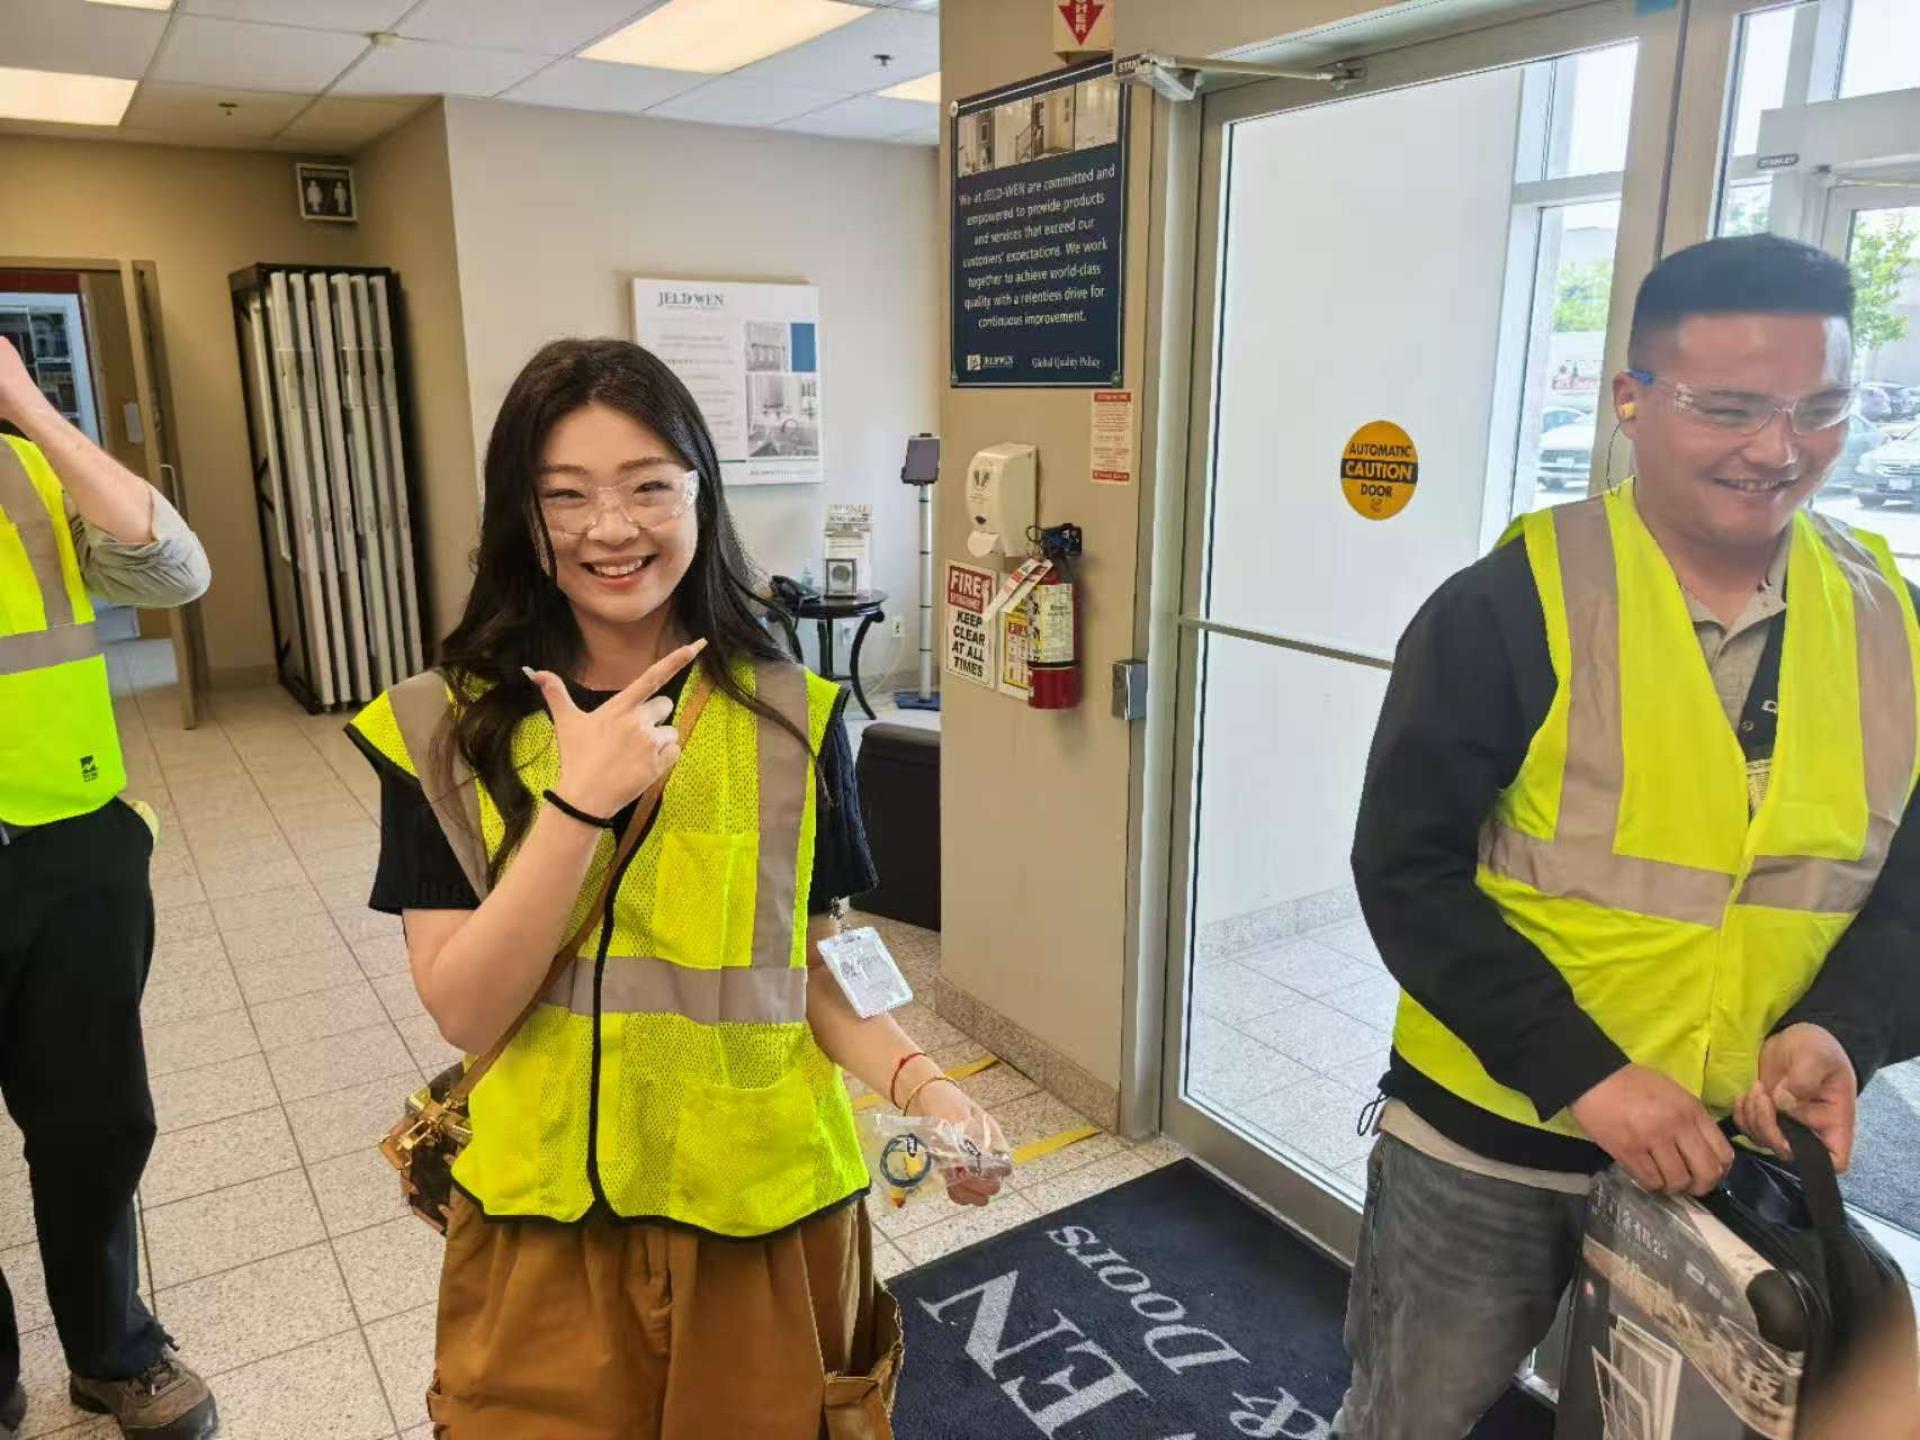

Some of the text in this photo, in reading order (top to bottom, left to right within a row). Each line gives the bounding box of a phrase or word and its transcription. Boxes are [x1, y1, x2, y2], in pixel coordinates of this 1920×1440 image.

[974, 192, 982, 204] at
[1027, 181, 1042, 194] are
[1044, 169, 1094, 190] committed
[1096, 163, 1115, 179] and
[967, 191, 1105, 226] empowered to provide products
[974, 217, 1095, 247] and services that exceed our
[1066, 242, 1081, 256] We
[1083, 237, 1108, 253] work
[968, 263, 1101, 290] together to achieve world-class
[964, 295, 991, 312] quality
[993, 293, 1012, 307] with
[1021, 290, 1062, 305] relentless
[1064, 287, 1088, 301] drive
[1090, 283, 1105, 298] for
[978, 311, 1087, 329] continuous improvement.
[1349, 443, 1411, 457] AUTOMATIC
[1345, 461, 1413, 480] CAUTION
[1361, 482, 1392, 497] DOOR
[951, 570, 982, 598] FIRE
[956, 611, 983, 627] KEEP
[953, 625, 985, 643] CLEAR
[952, 641, 984, 662] AT ALL
[954, 656, 983, 678] TIMES
[1045, 1225, 1250, 1375] Doors
